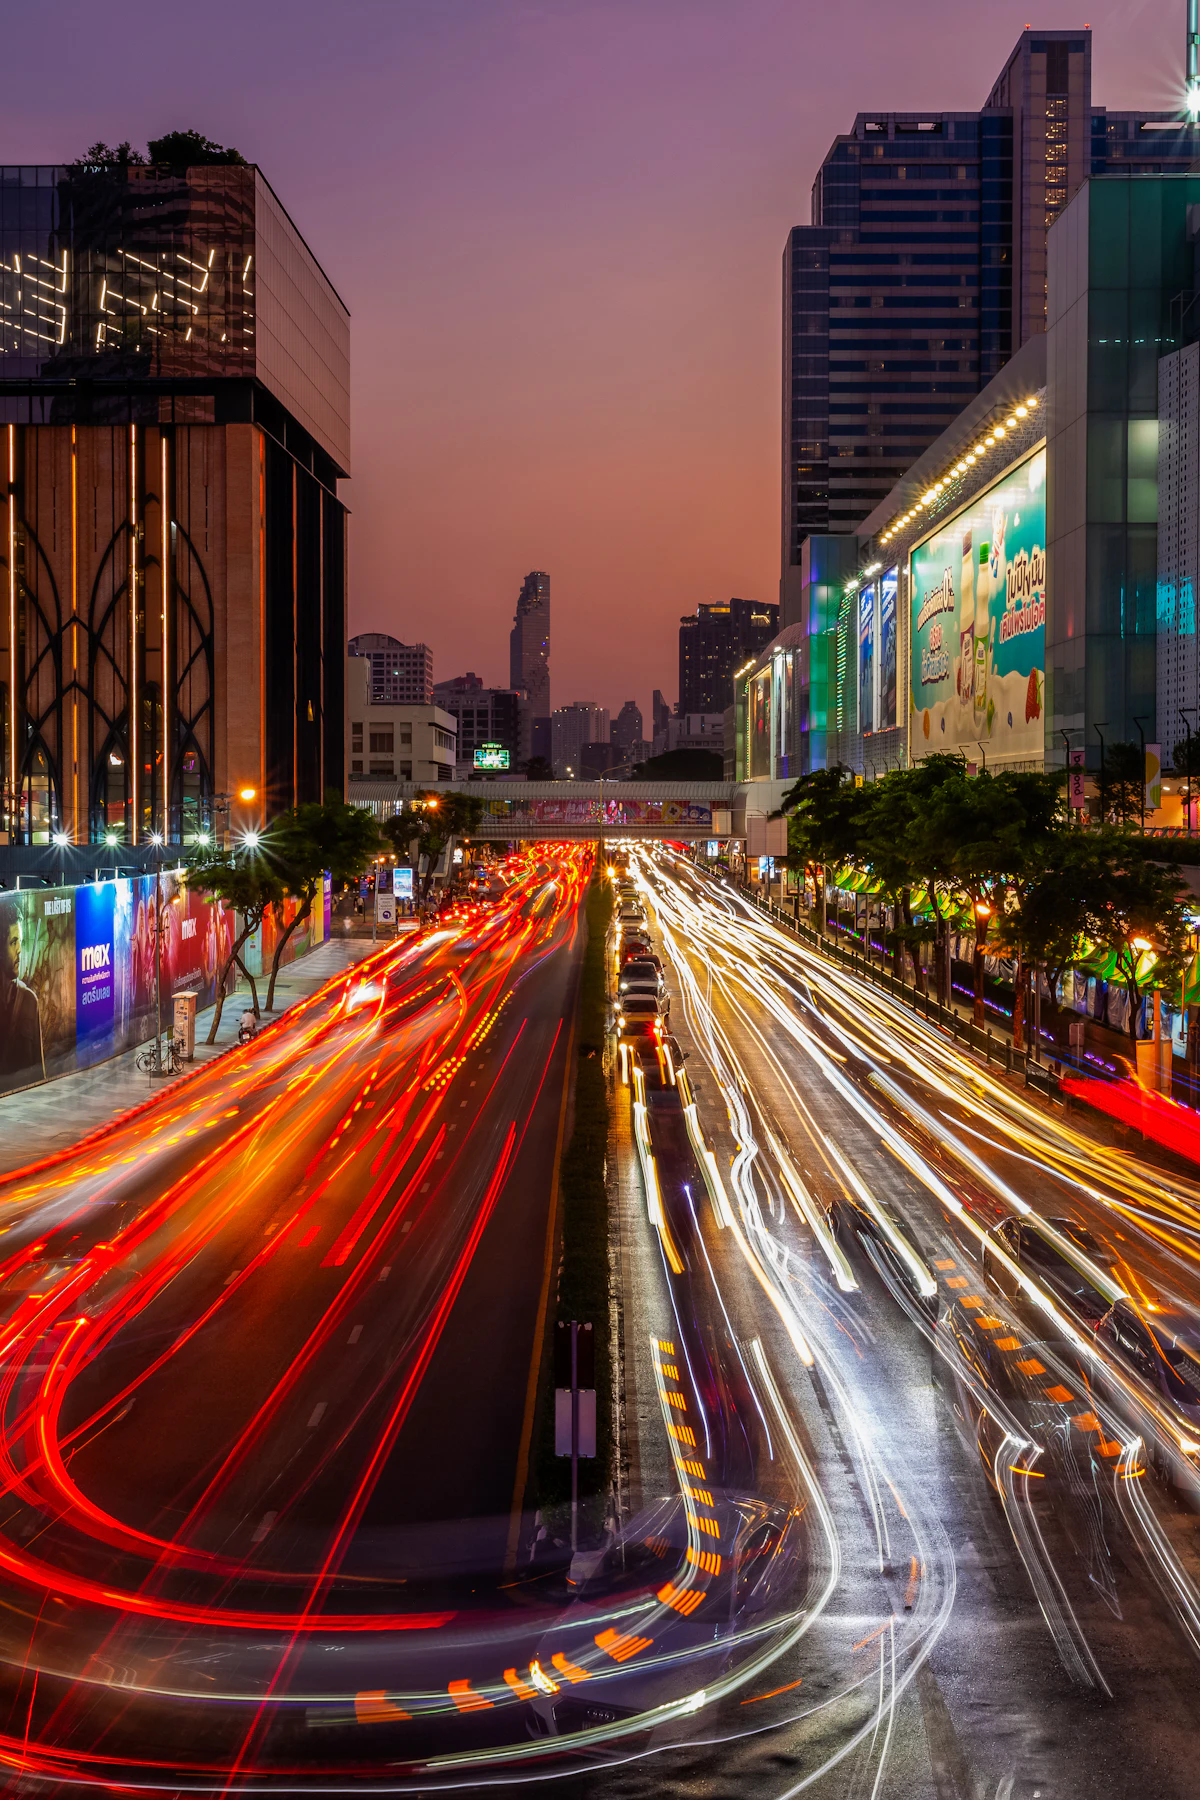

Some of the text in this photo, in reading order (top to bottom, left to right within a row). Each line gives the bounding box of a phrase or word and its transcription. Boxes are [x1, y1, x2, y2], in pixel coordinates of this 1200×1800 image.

[44, 901, 52, 916] THE
[52, 900, 61, 915] LAST
[182, 918, 197, 940] max
[82, 943, 110, 971] max
[82, 985, 110, 1005] สตรีมเลย
